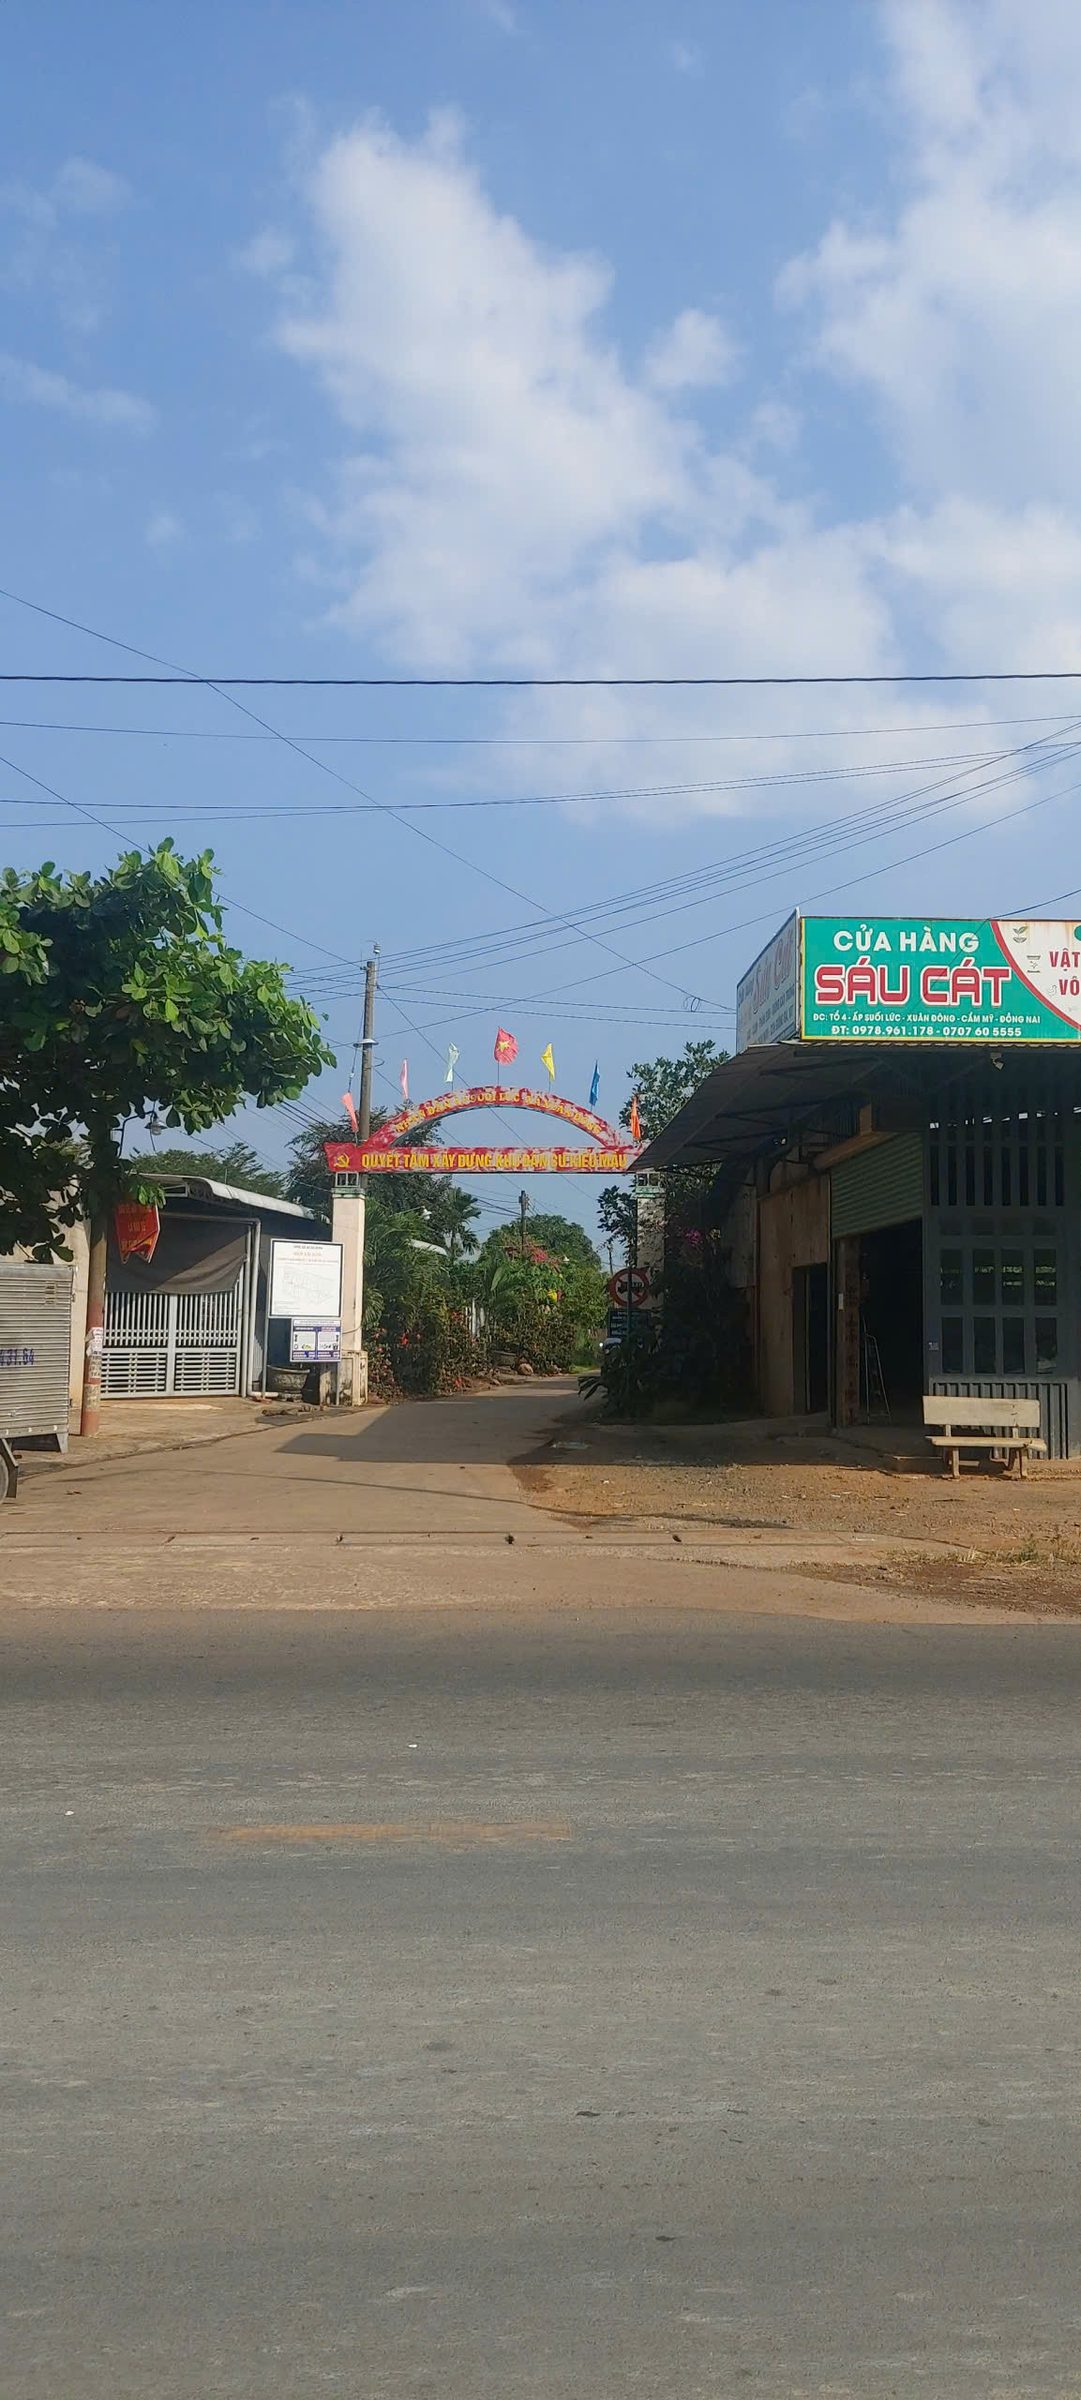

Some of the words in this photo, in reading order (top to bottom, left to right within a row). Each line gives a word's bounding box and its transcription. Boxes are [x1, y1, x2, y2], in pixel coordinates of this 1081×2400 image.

[833, 924, 892, 952] CỬA
[899, 926, 980, 953] HÀNG
[1049, 948, 1081, 972] VẬT
[815, 956, 910, 1006] SÁU
[921, 957, 1012, 1007] CÁT
[841, 1013, 847, 1021] 4
[852, 1010, 863, 1022] ẤP
[864, 1011, 884, 1022] SUỐI
[907, 1012, 930, 1022] XUÂN
[1025, 1015, 1041, 1024] NAI
[831, 1025, 850, 1035] ĐT:
[852, 1025, 934, 1036] 0978.961.178
[942, 1026, 972, 1036] 0707
[974, 1027, 990, 1036] 60
[992, 1027, 1022, 1037] 5555
